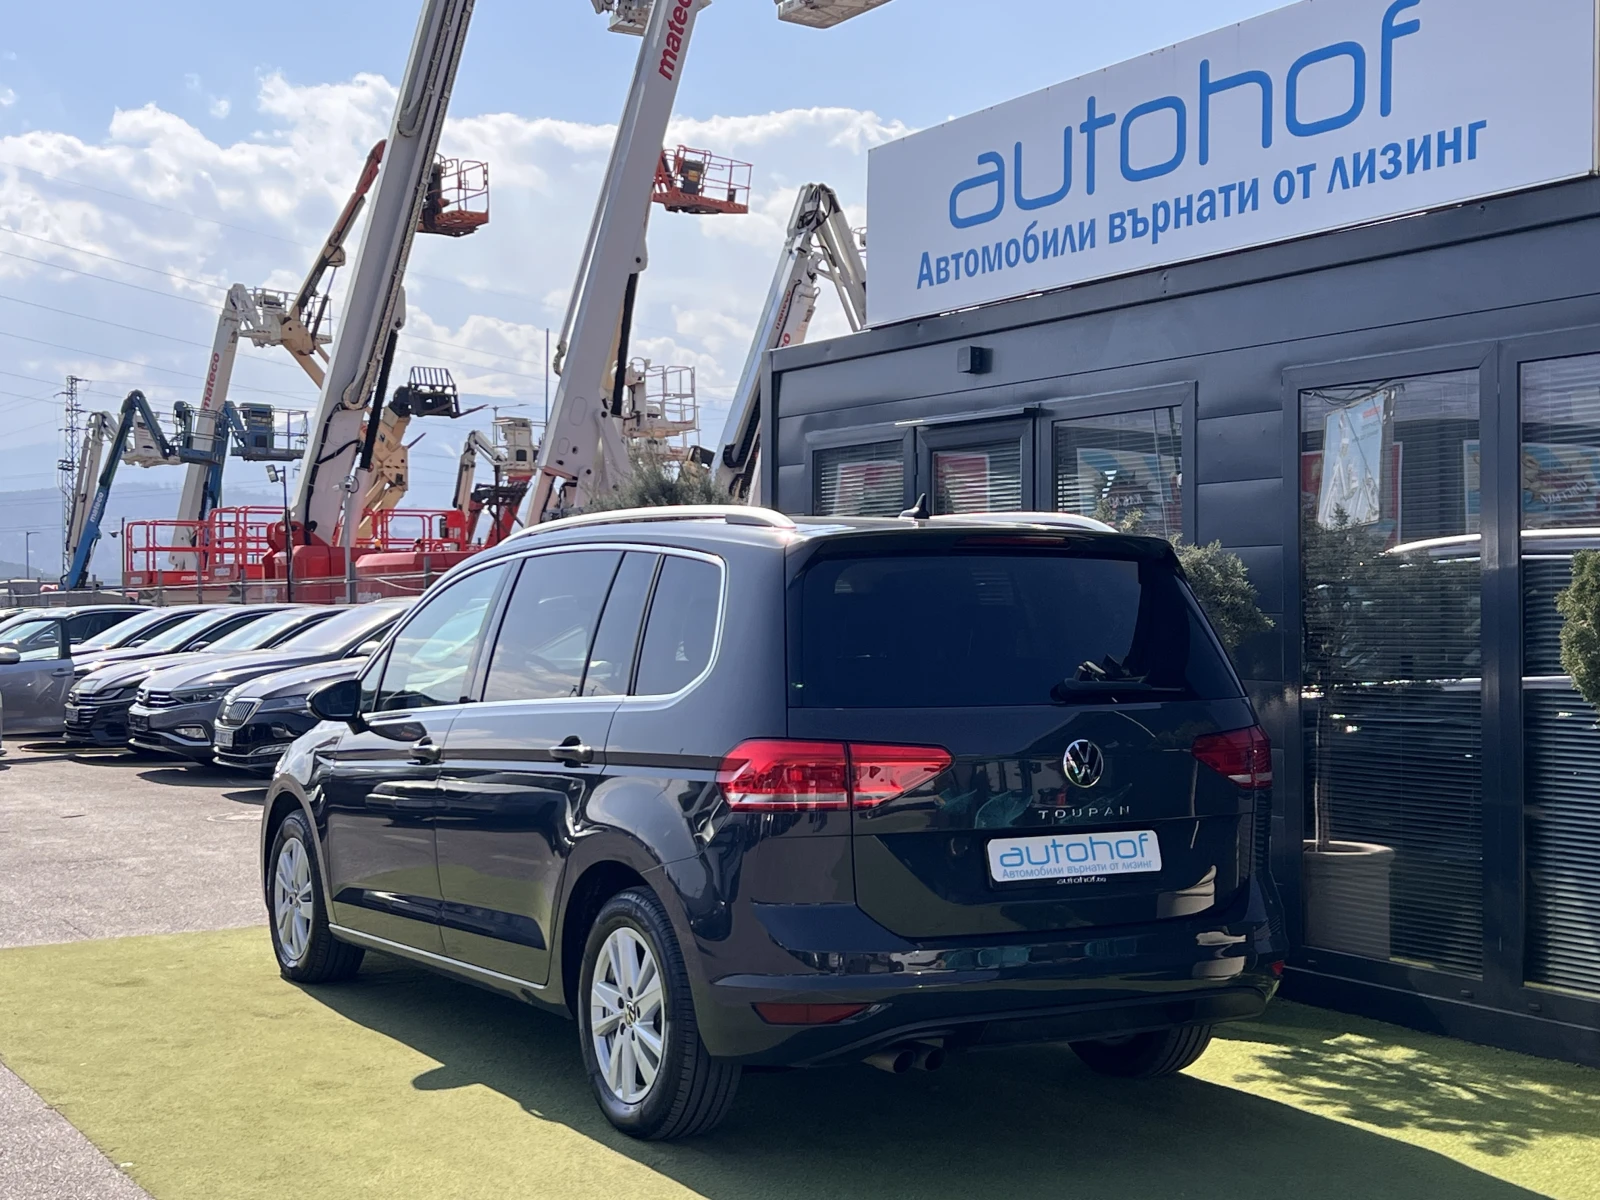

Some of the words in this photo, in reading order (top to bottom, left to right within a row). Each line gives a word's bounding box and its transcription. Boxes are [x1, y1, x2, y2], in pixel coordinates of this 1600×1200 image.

[949, 0, 1420, 229] autohof
[916, 220, 1097, 290] Автомобили
[1107, 180, 1260, 246] върнати
[1272, 162, 1318, 205] от
[1326, 119, 1488, 195] лизинг
[203, 352, 220, 411] mateco
[90, 492, 104, 523] mateco
[999, 832, 1149, 867] autohof
[1002, 865, 1065, 879] Автомобили
[1066, 863, 1108, 875] върнати
[1109, 863, 1119, 871] от
[1121, 860, 1153, 870] лизинг
